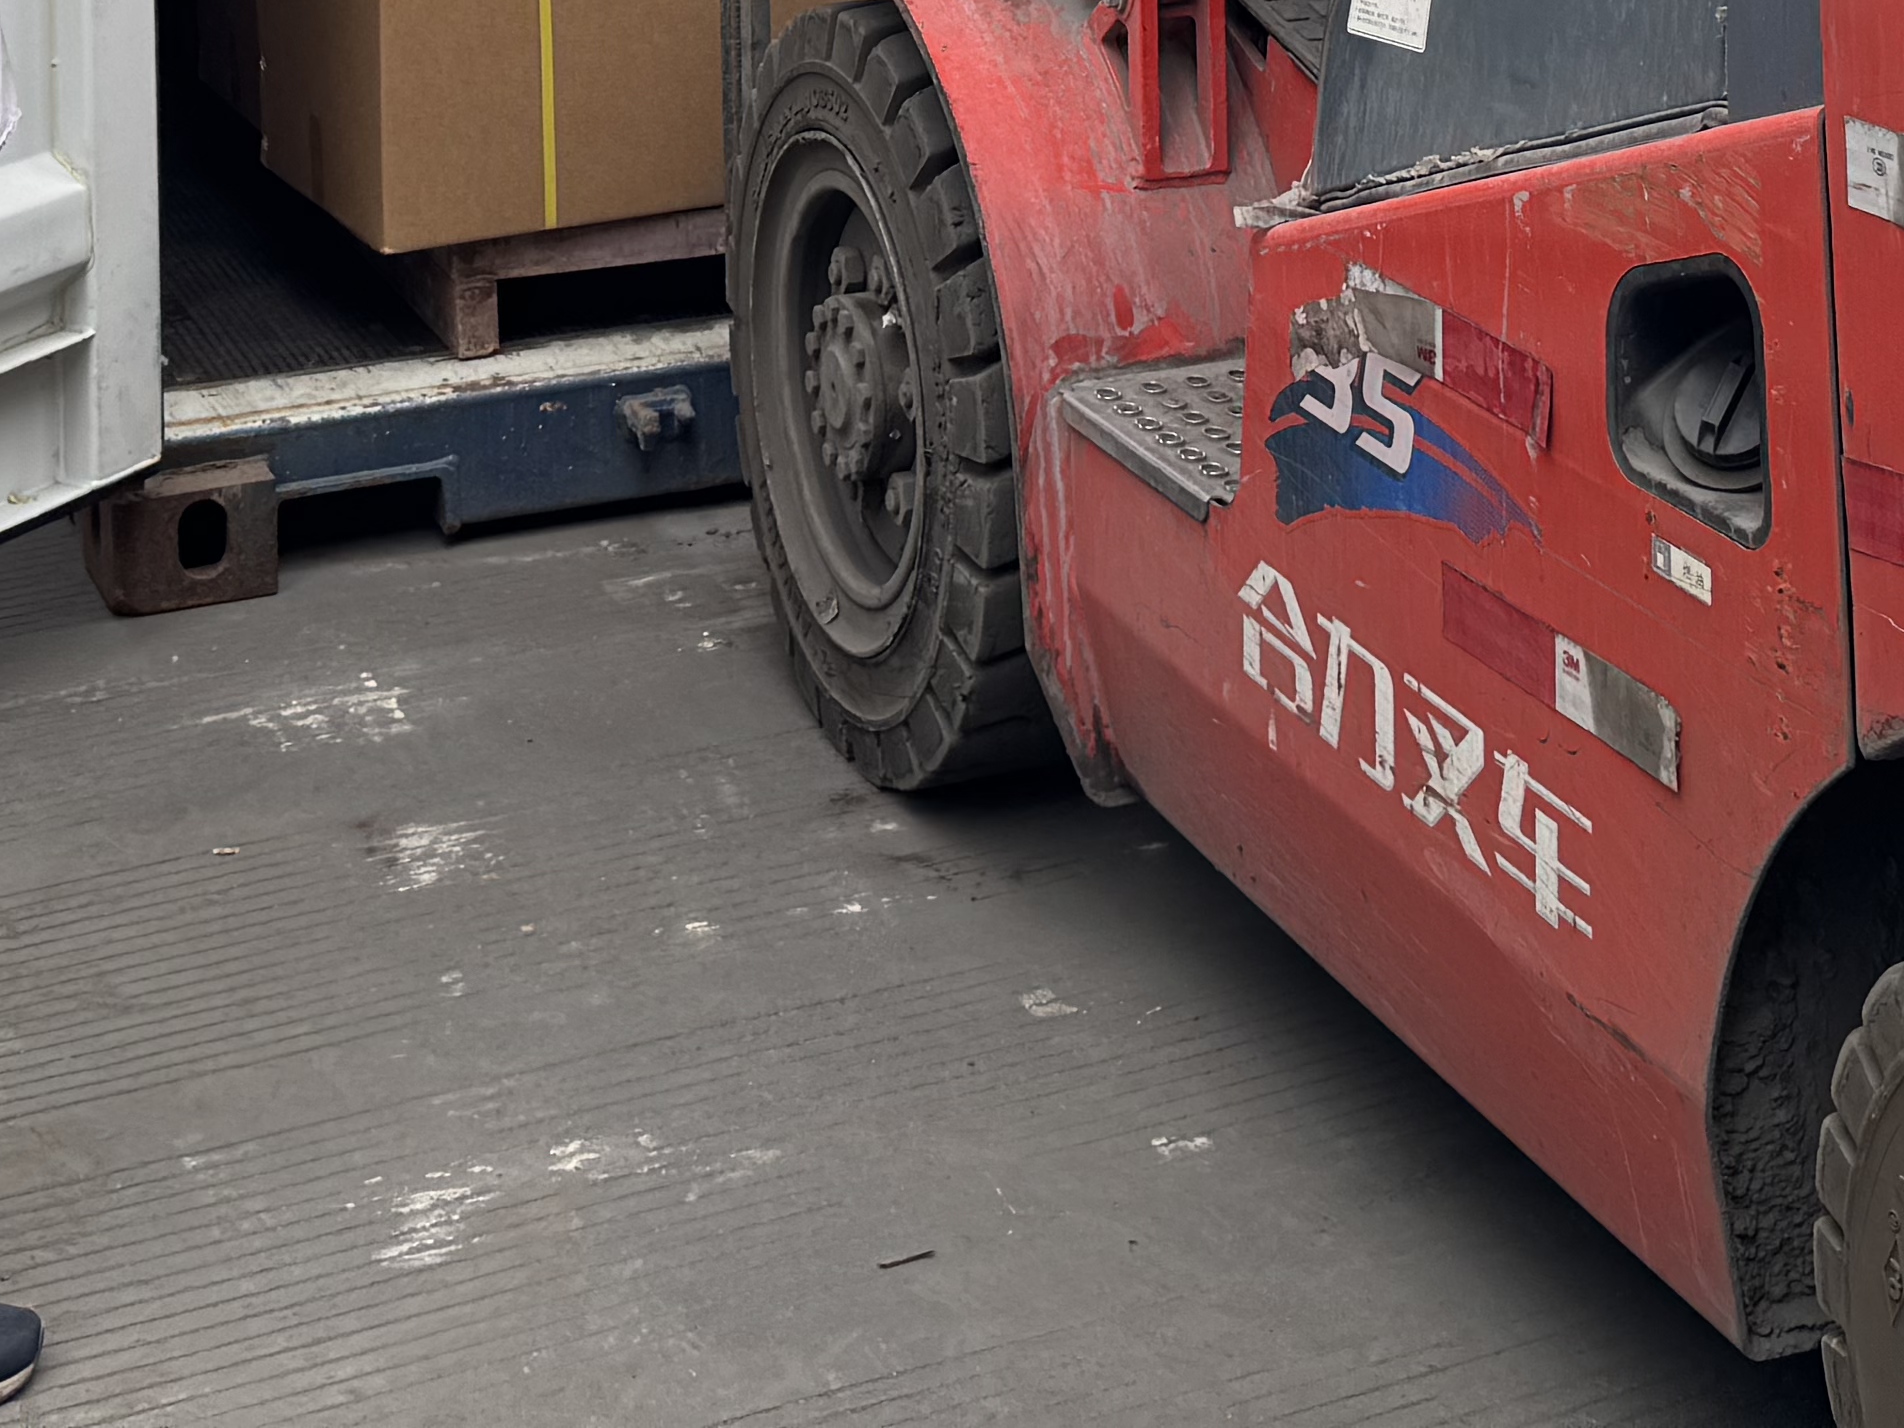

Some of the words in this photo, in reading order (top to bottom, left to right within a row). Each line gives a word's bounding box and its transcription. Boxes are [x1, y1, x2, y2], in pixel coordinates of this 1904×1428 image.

[1237, 559, 1594, 941] 合力叉车
[1562, 649, 1581, 675] 3M
